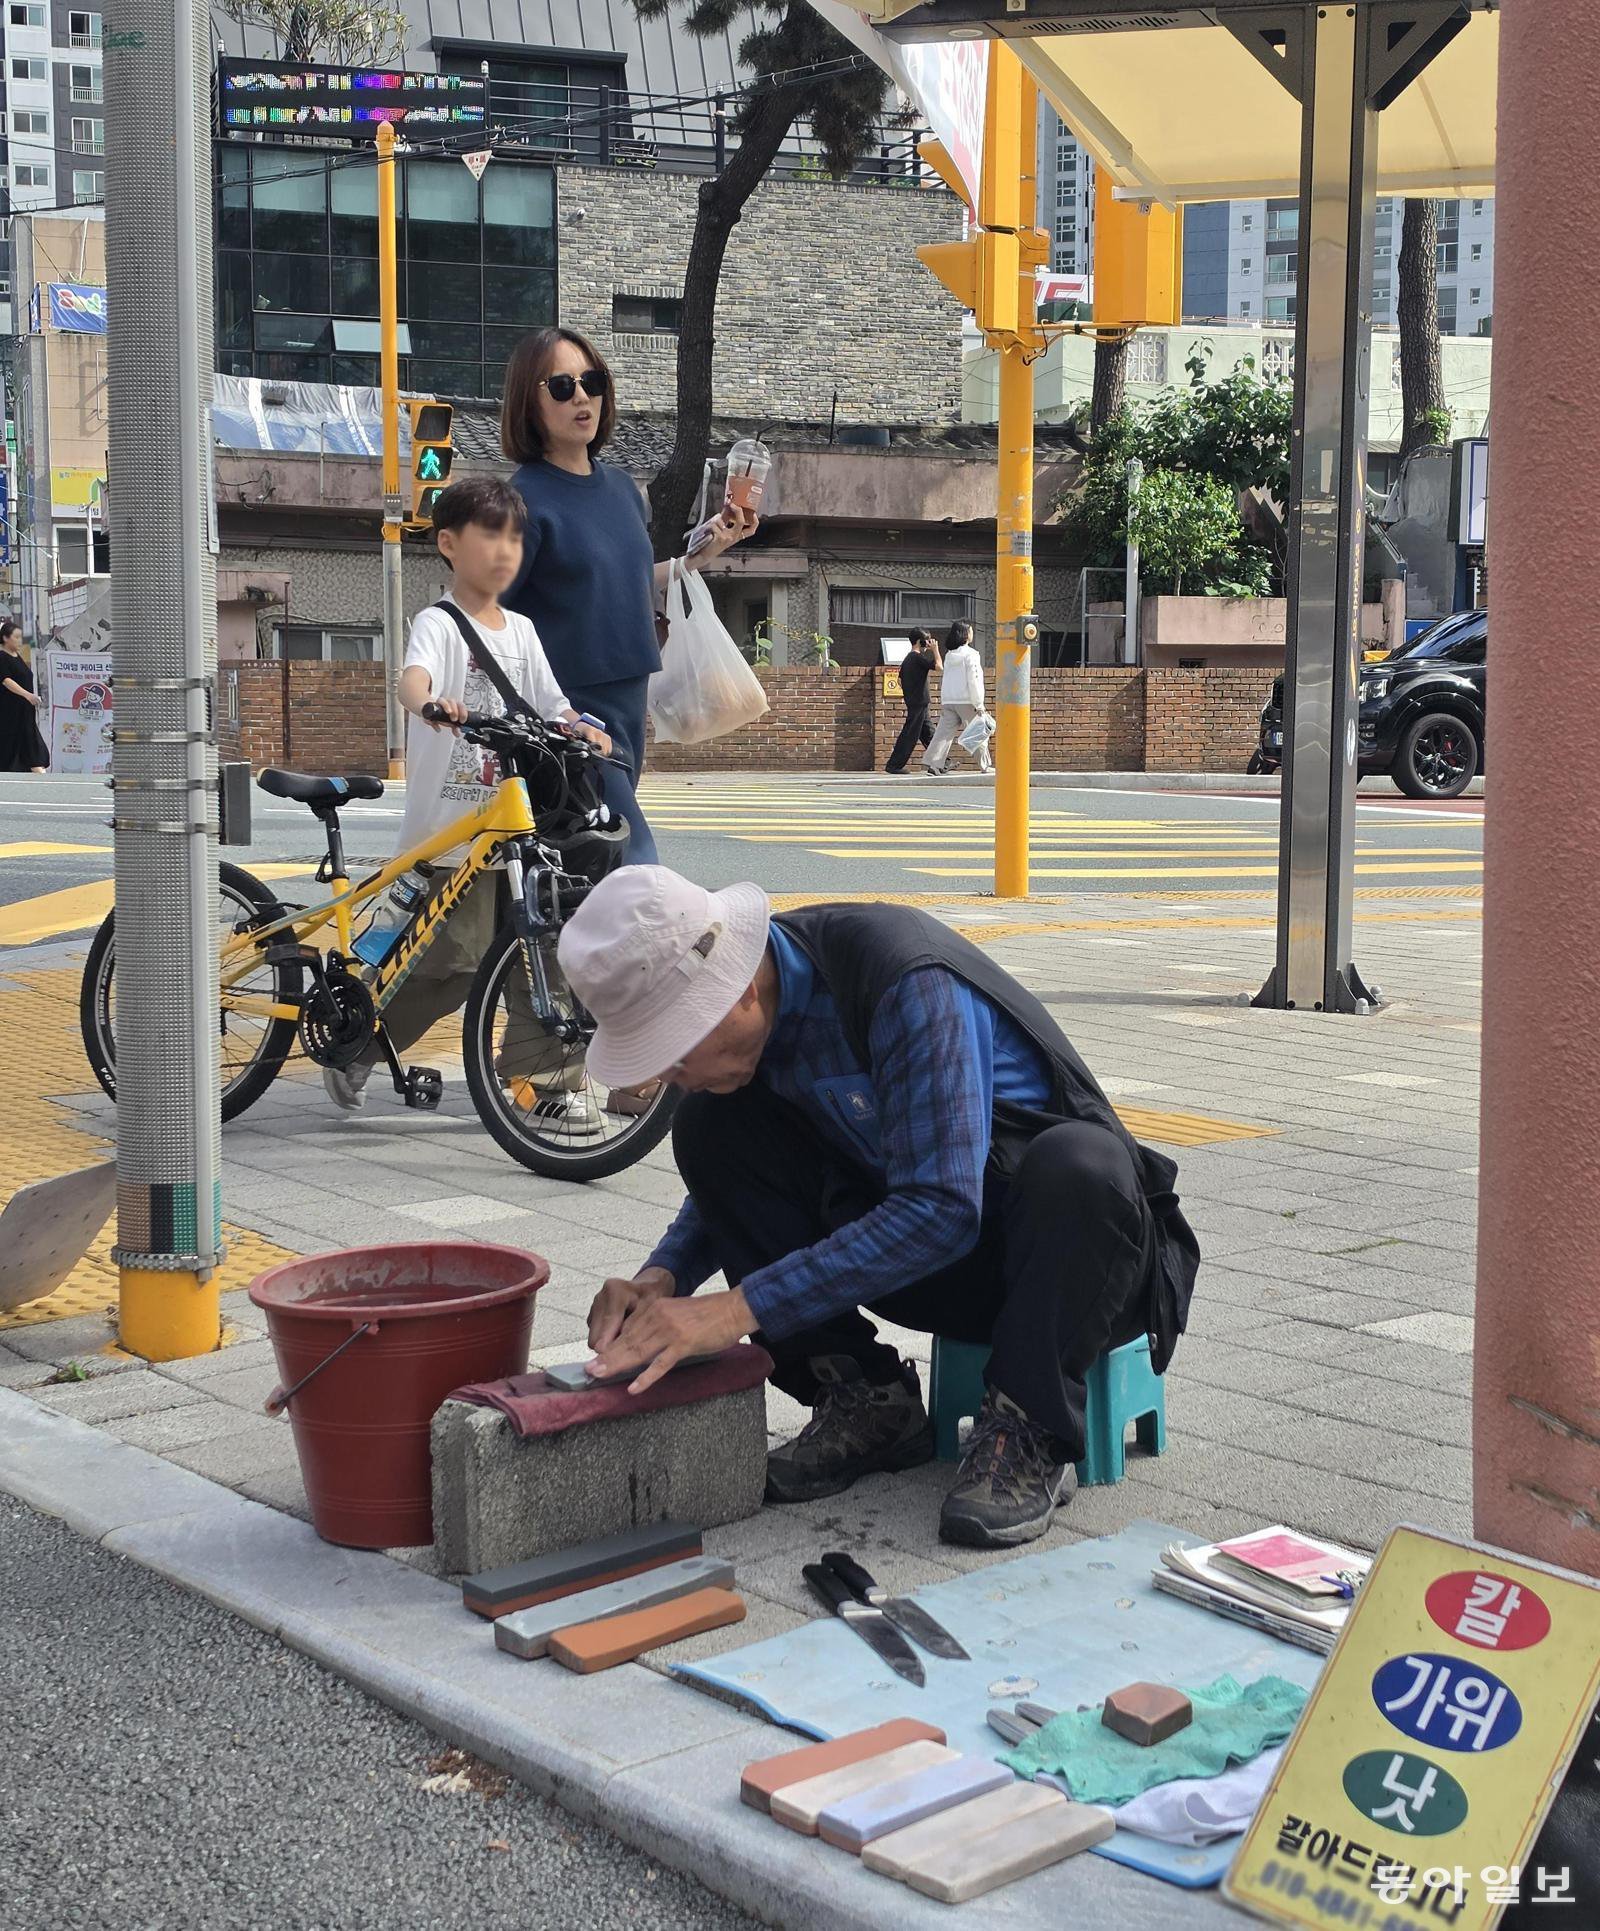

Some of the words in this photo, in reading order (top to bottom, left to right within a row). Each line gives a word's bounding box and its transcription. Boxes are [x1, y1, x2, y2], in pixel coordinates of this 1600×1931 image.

[80, 663, 103, 671] 케이크
[440, 785, 481, 803] KEITH
[1454, 1573, 1521, 1648] 칼
[1384, 1654, 1508, 1751] 가위
[1370, 1753, 1438, 1832] 낫
